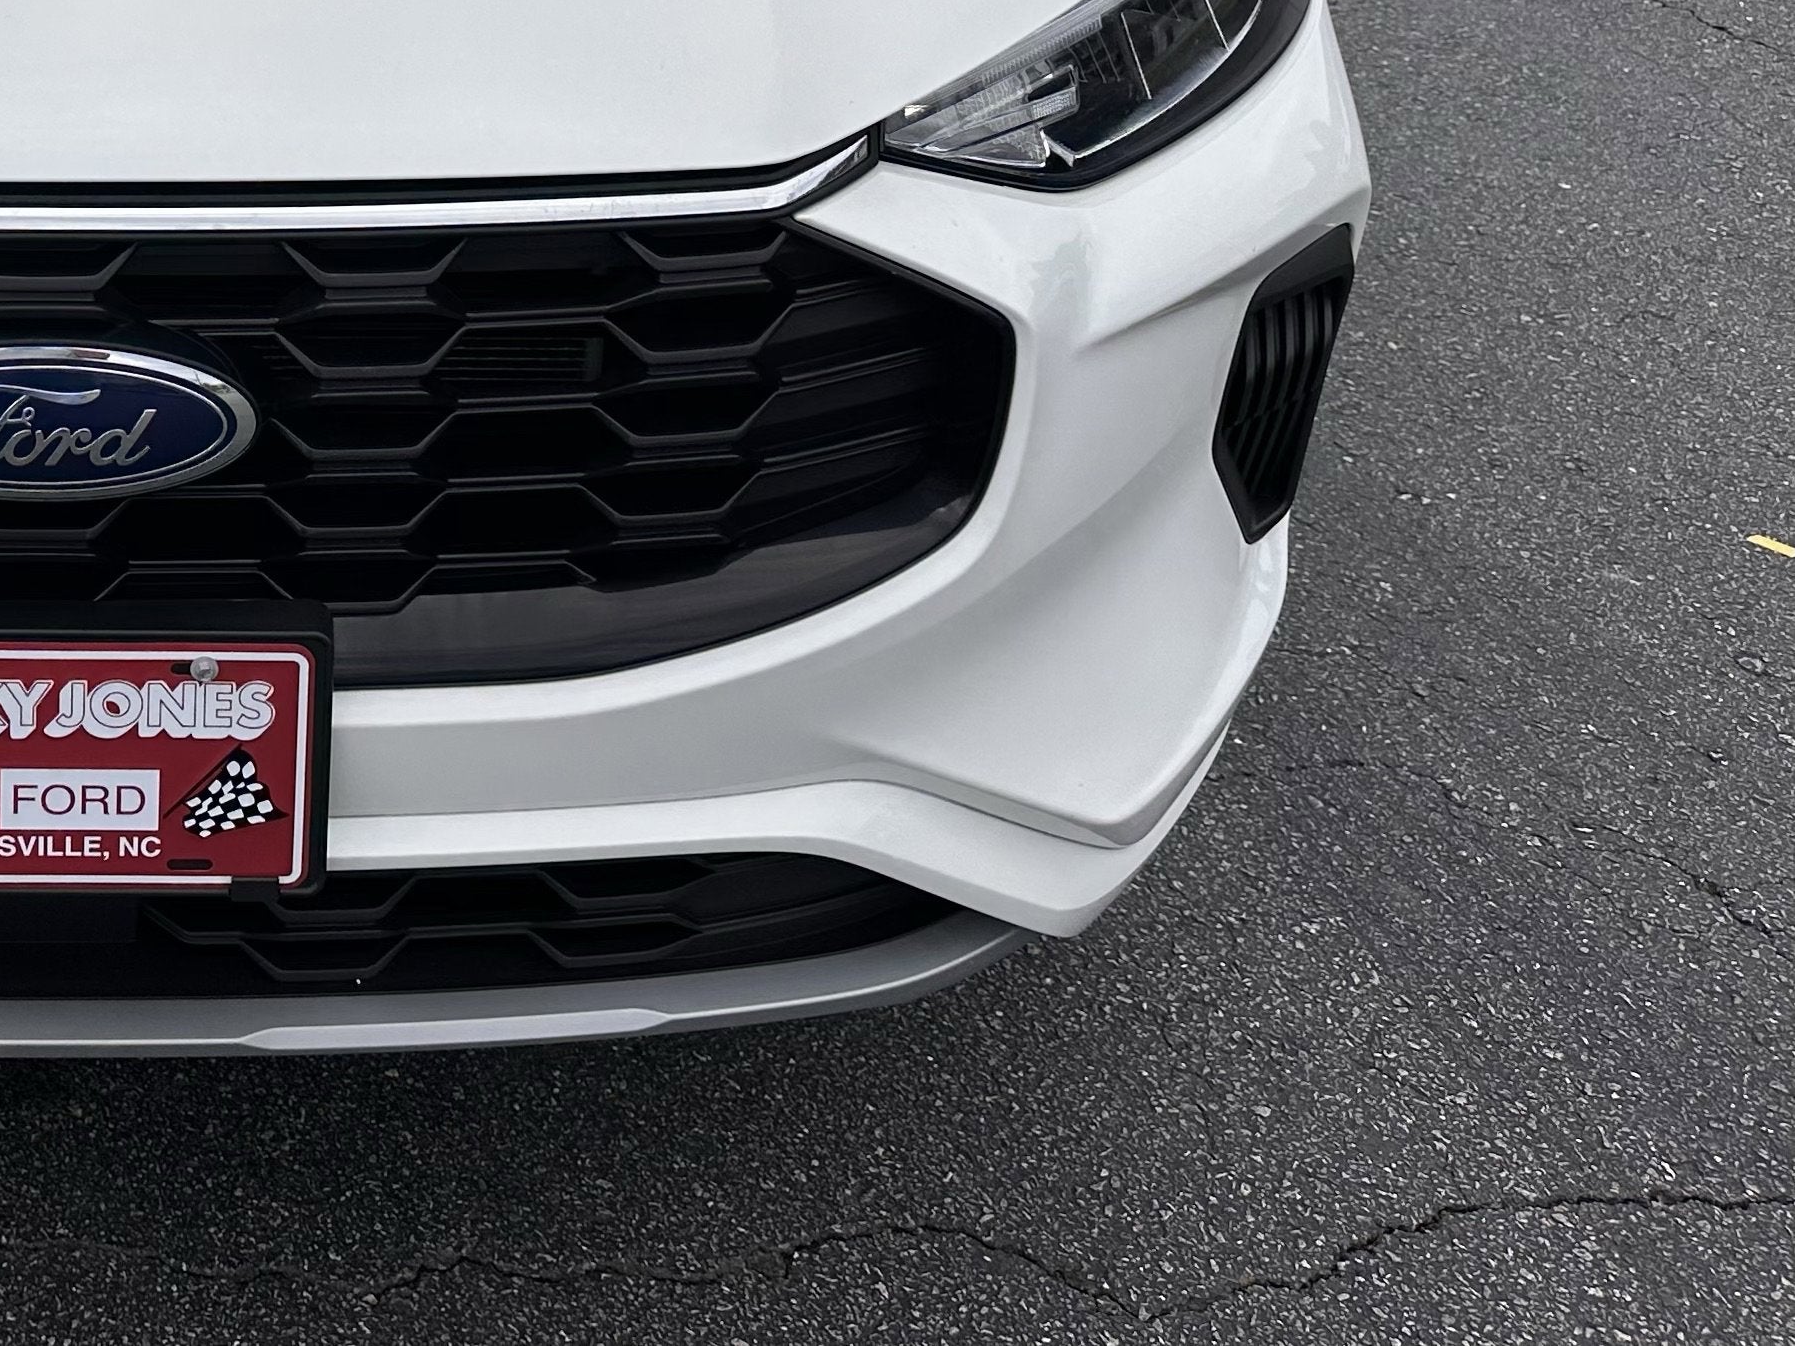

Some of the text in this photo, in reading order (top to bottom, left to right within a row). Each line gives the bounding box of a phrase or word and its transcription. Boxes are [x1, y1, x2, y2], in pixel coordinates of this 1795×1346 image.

[44, 680, 275, 740] JONES
[12, 784, 147, 817] FORD
[119, 836, 162, 858] NC
